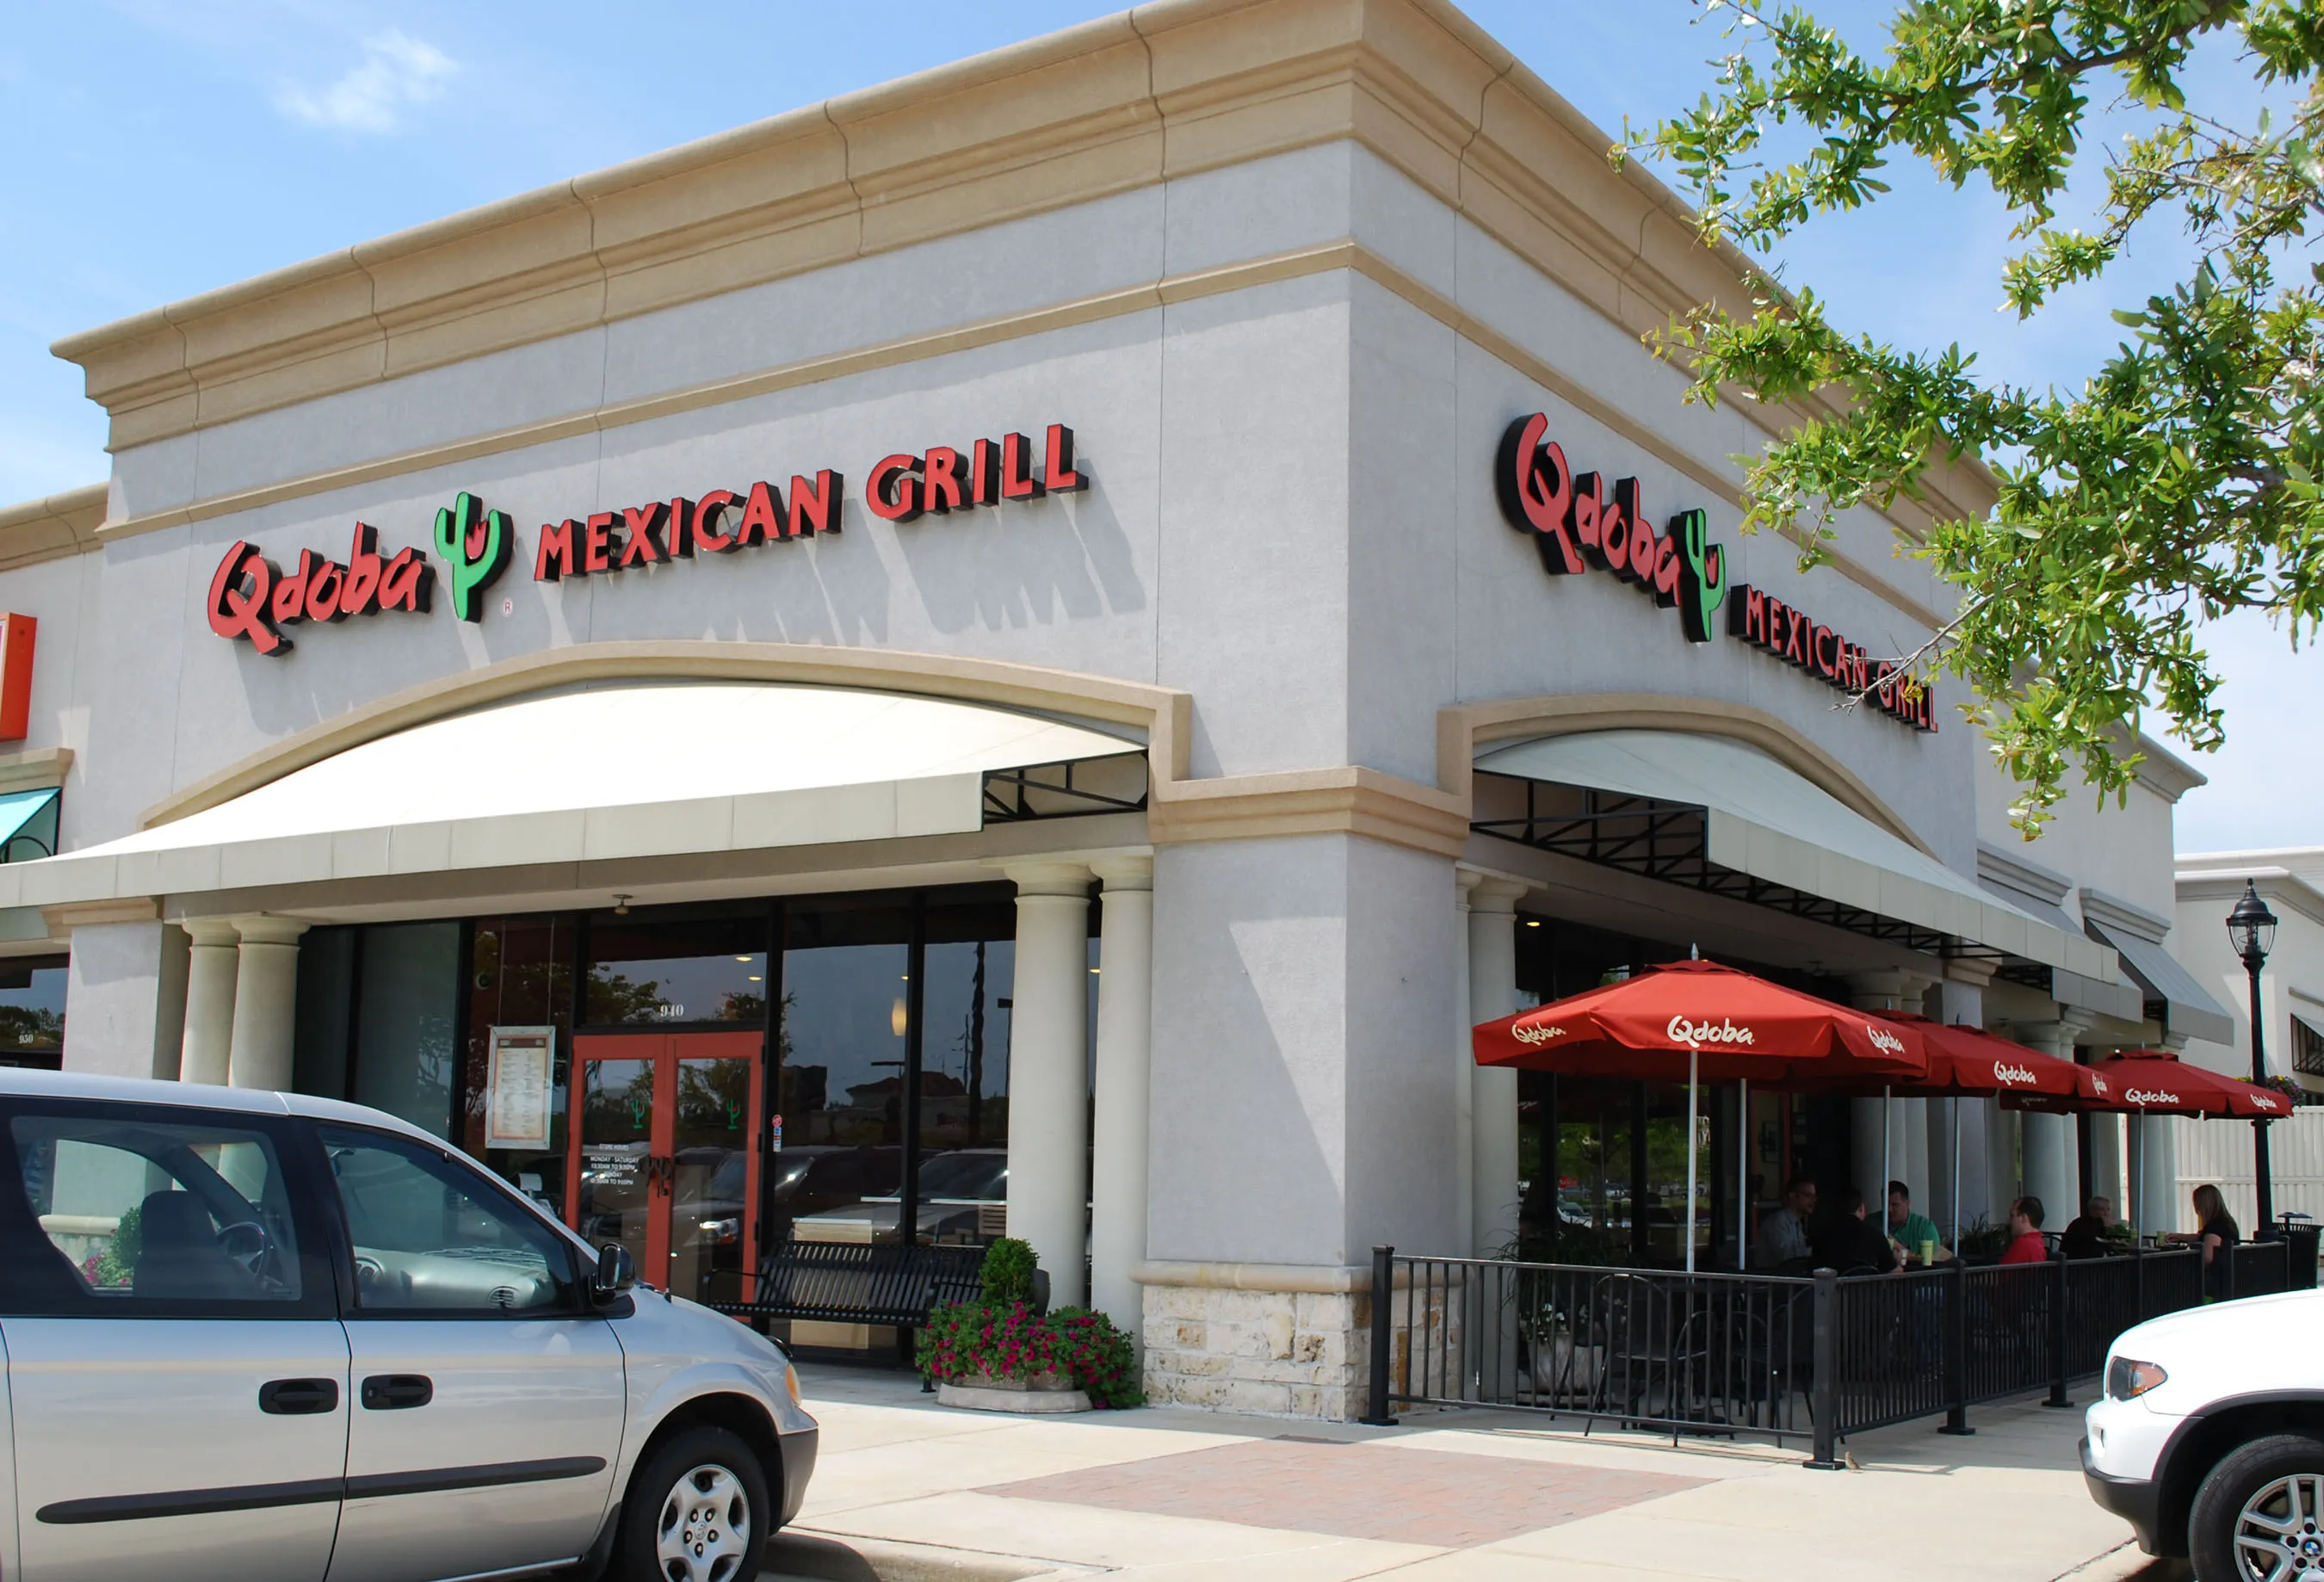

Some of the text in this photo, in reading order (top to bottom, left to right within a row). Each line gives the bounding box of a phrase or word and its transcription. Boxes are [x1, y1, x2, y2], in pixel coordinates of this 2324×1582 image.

[207, 423, 1087, 656] Qdoba MEXICAN GRILL
[1498, 412, 1681, 608] Qdoba
[1735, 584, 1868, 691] MEXICAN
[1511, 1022, 1567, 1046] Qdoba
[1666, 1015, 1754, 1048] Qdoba
[1866, 1025, 1906, 1055] Qdoba
[1993, 1060, 2037, 1086] Qdoba
[2124, 1087, 2179, 1106] Qdoba
